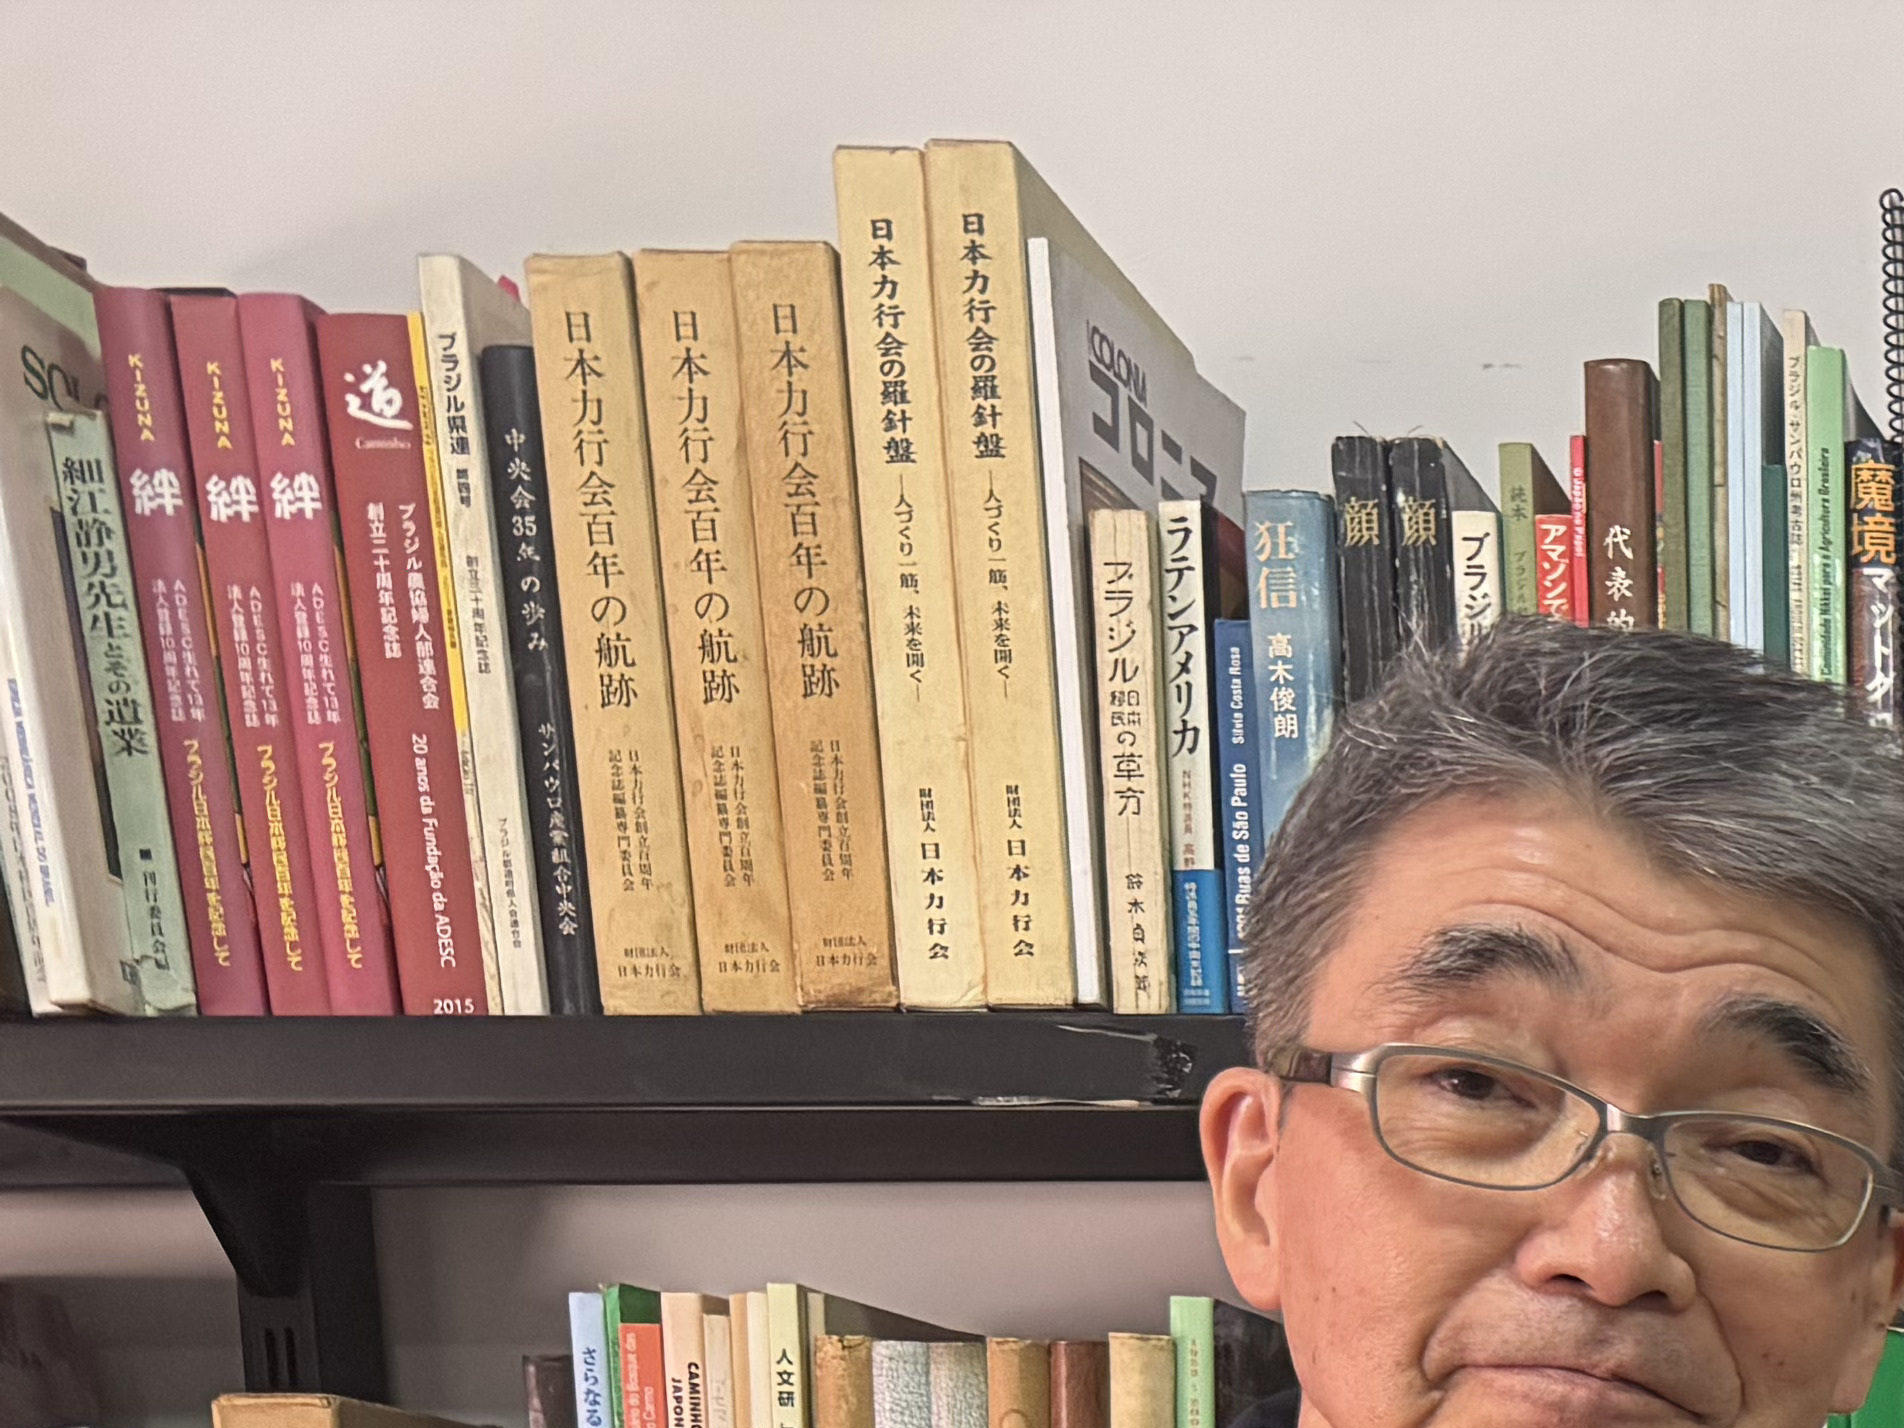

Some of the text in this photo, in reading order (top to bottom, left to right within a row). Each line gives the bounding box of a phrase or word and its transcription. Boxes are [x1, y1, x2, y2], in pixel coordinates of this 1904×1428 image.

[869, 218, 918, 464] 日本力行会の羅針盤
[959, 211, 1008, 461] 日本力行会の羅針盤
[128, 353, 155, 442] KIZUNA
[207, 361, 233, 449] KIZUNA
[270, 359, 296, 447] KIZUNA
[343, 359, 414, 430] 道
[437, 332, 470, 455] ブラジル県連
[131, 468, 184, 518] 絆
[205, 474, 259, 523] 絆
[270, 471, 323, 520] 絆
[504, 429, 547, 651] 中央会35年の歩み
[562, 310, 638, 709] 日本力行会百年の航跡
[672, 310, 740, 707] 日本力行会百年の航跡
[770, 303, 841, 699] 日本力行会百年の航跡
[1344, 498, 1379, 547] 顔
[1401, 498, 1436, 547] 顔
[1852, 462, 1896, 565] 魔境
[61, 457, 152, 758] 細江静男先生とその遺業
[1253, 520, 1297, 610] 狂信
[1166, 516, 1200, 755] ラテンアメリカ
[1267, 632, 1299, 739] 高木俊朗
[411, 734, 456, 968] 20 anos da Fundação da ADESC
[1229, 764, 1252, 904] Ruas de São Paulo
[920, 840, 951, 962] 日本力行会
[1007, 838, 1036, 958] 日本力行会
[433, 999, 474, 1013] 2015
[776, 1348, 795, 1408] 人文研
